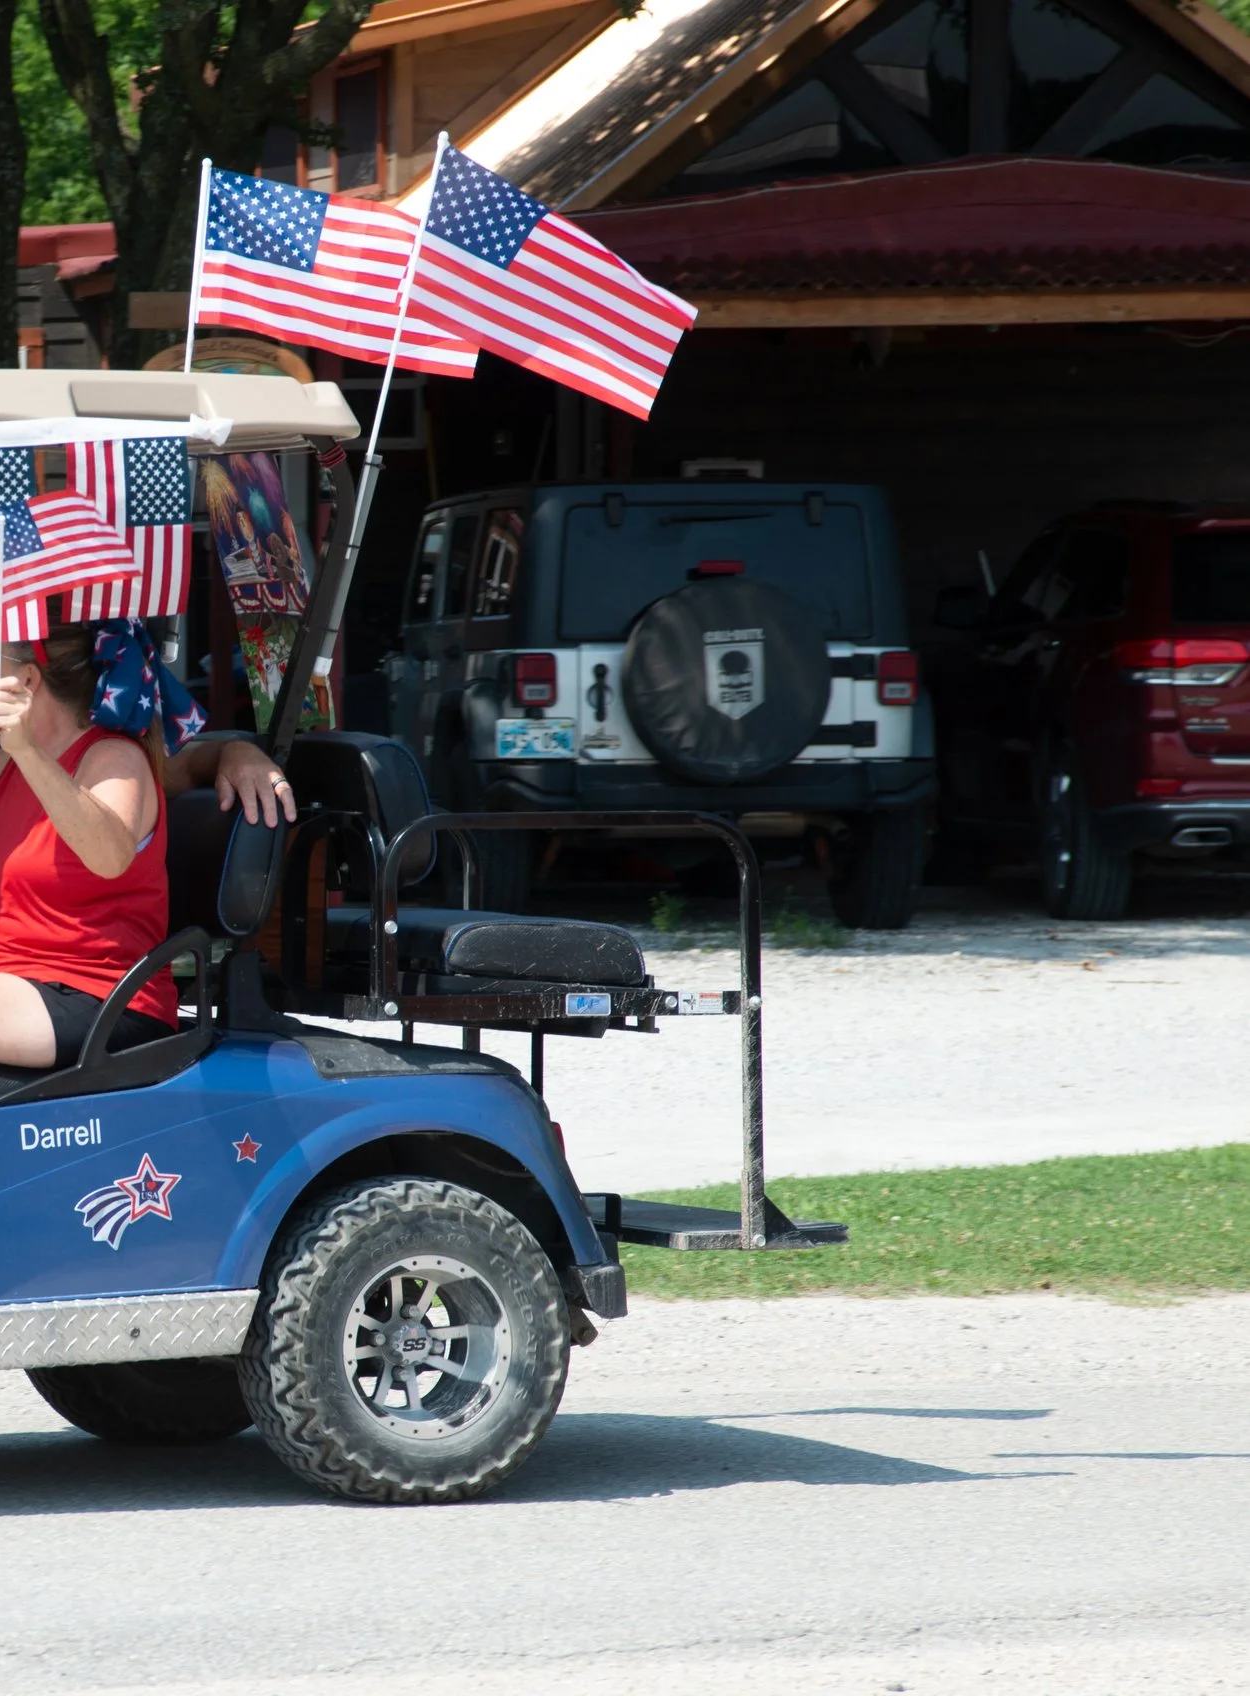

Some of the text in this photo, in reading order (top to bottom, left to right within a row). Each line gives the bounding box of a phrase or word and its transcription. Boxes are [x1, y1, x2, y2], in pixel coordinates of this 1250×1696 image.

[20, 1118, 102, 1151] Darrell
[141, 1191, 159, 1200] USA
[402, 1337, 427, 1352] SS
